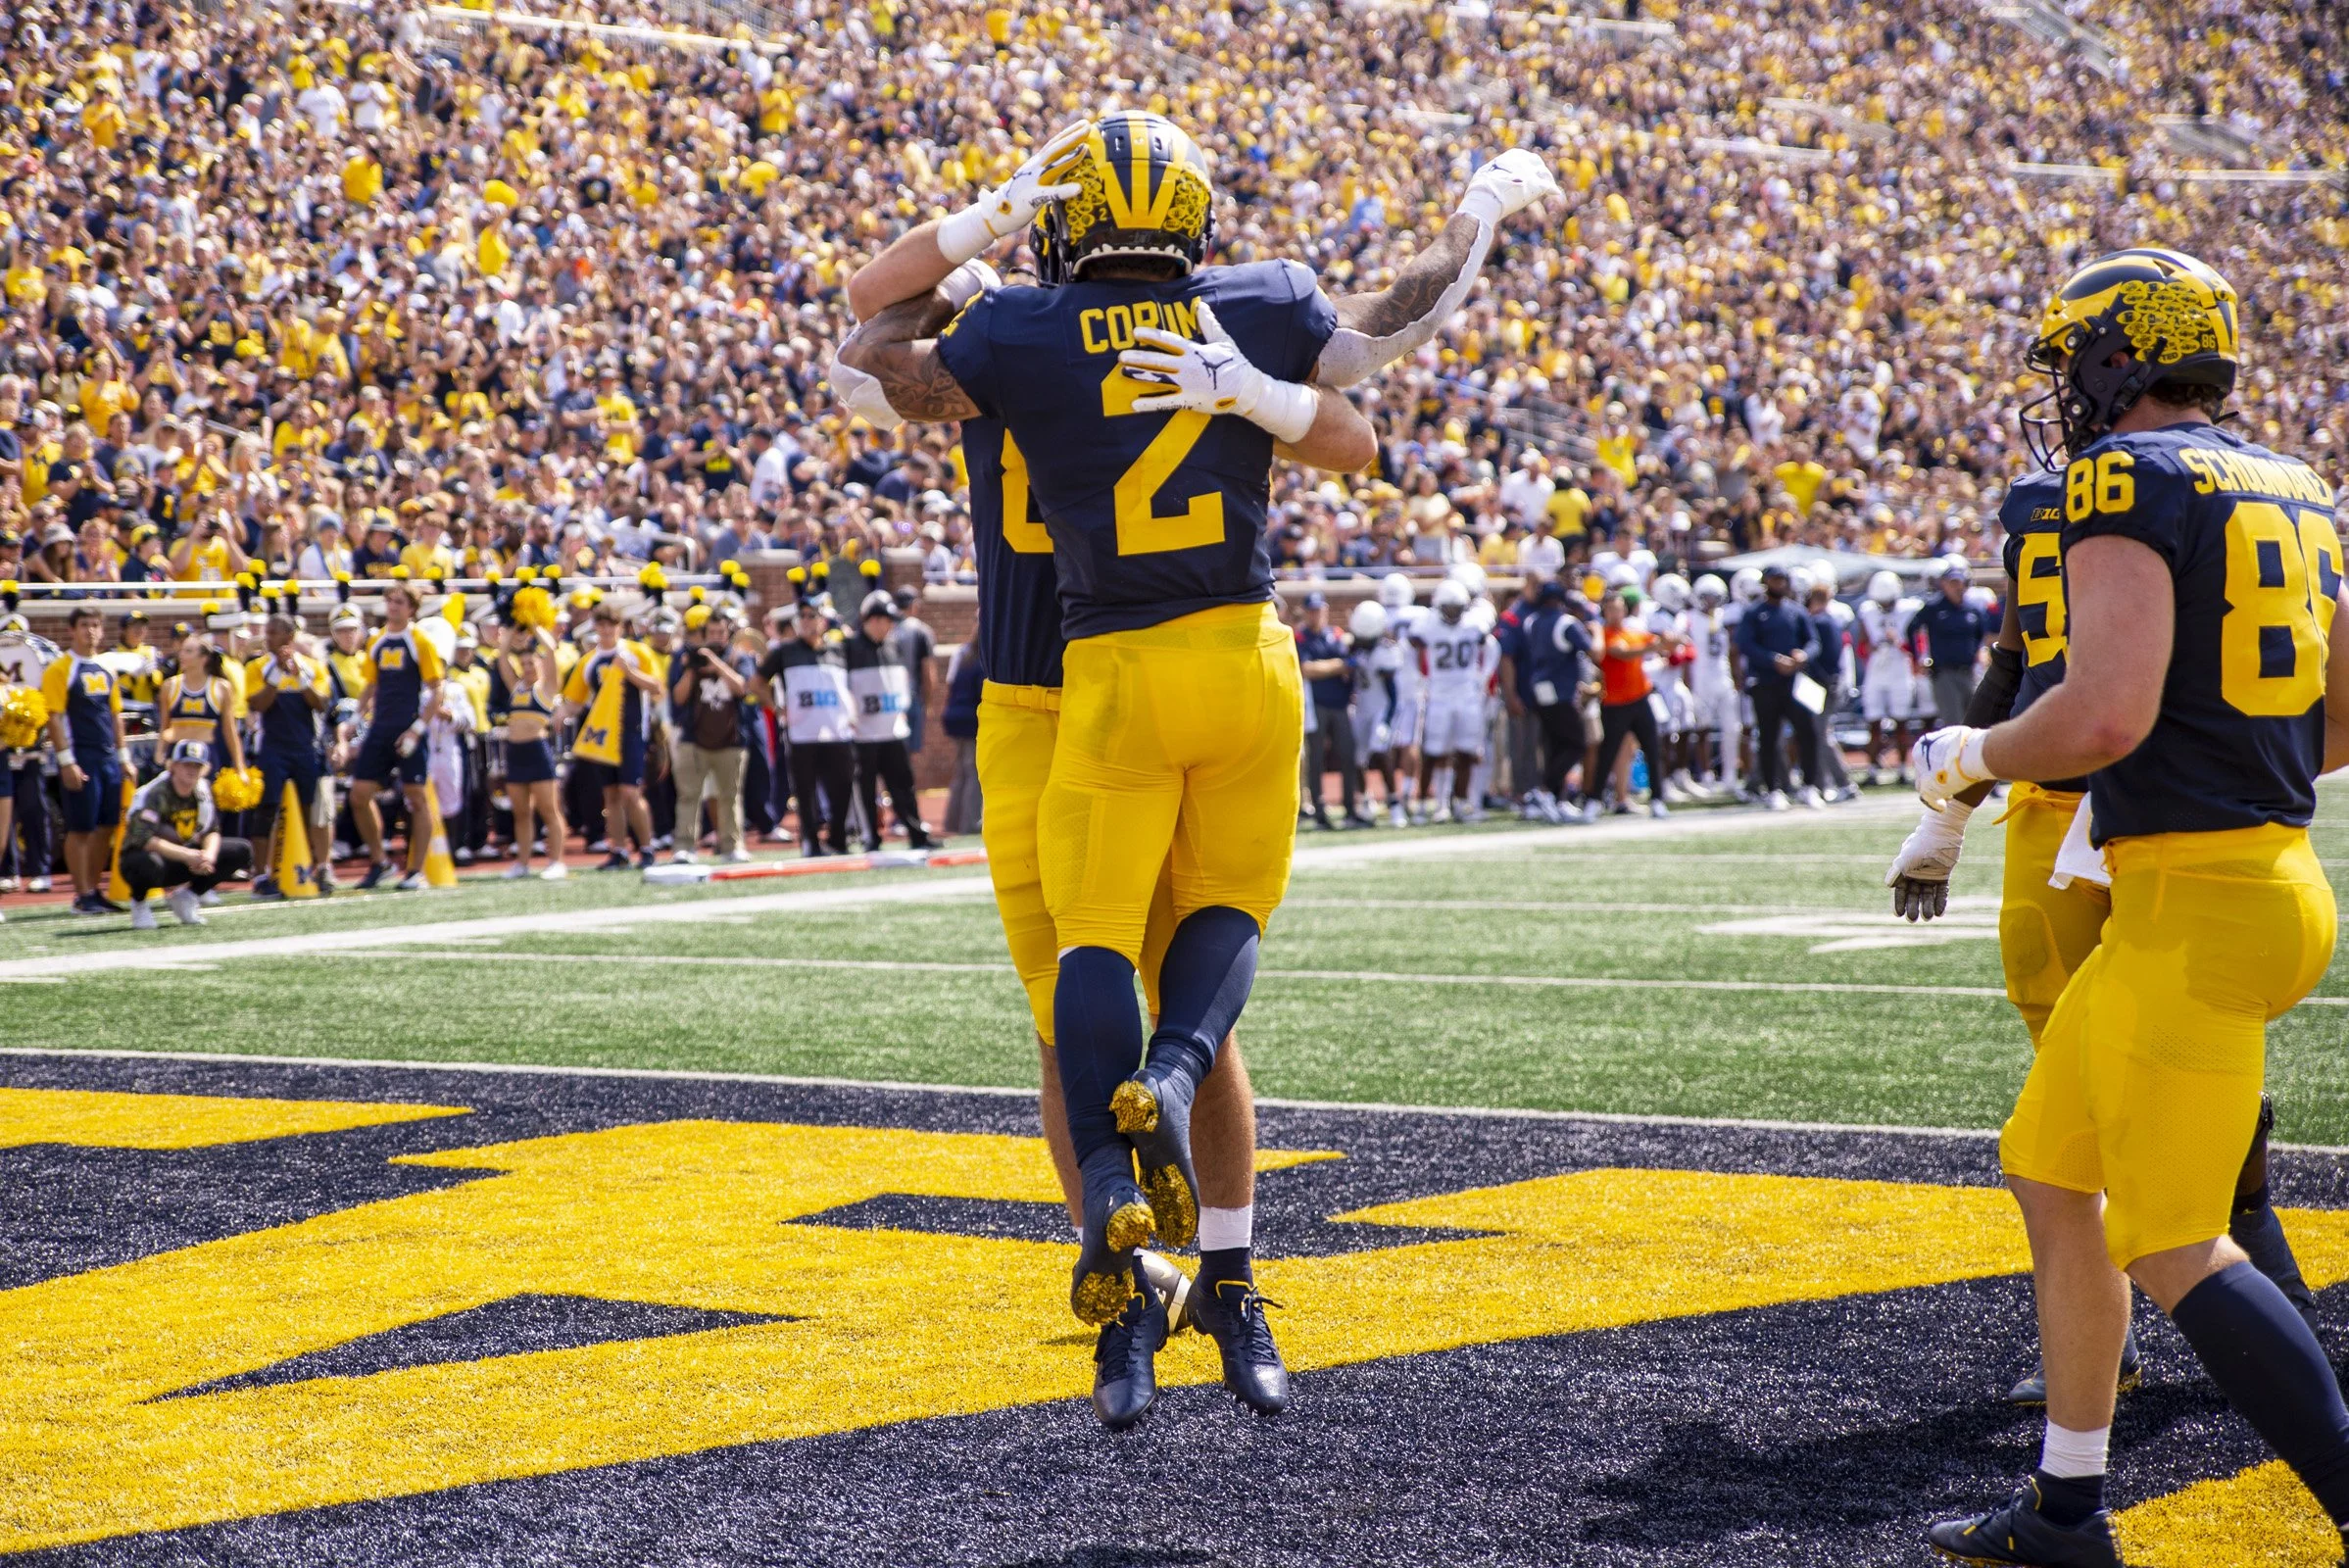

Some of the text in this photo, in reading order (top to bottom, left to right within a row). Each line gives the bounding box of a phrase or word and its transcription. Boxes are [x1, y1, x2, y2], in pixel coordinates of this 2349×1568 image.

[1099, 207, 1107, 221] 2
[2201, 334, 2216, 349] 86
[1101, 361, 1226, 556] 2
[2065, 450, 2135, 523] 86
[2221, 501, 2343, 716] 86
[378, 646, 405, 670] M
[1435, 641, 1472, 670] 20
[80, 670, 110, 696] M
[181, 697, 206, 714] M
[581, 726, 608, 746] M
